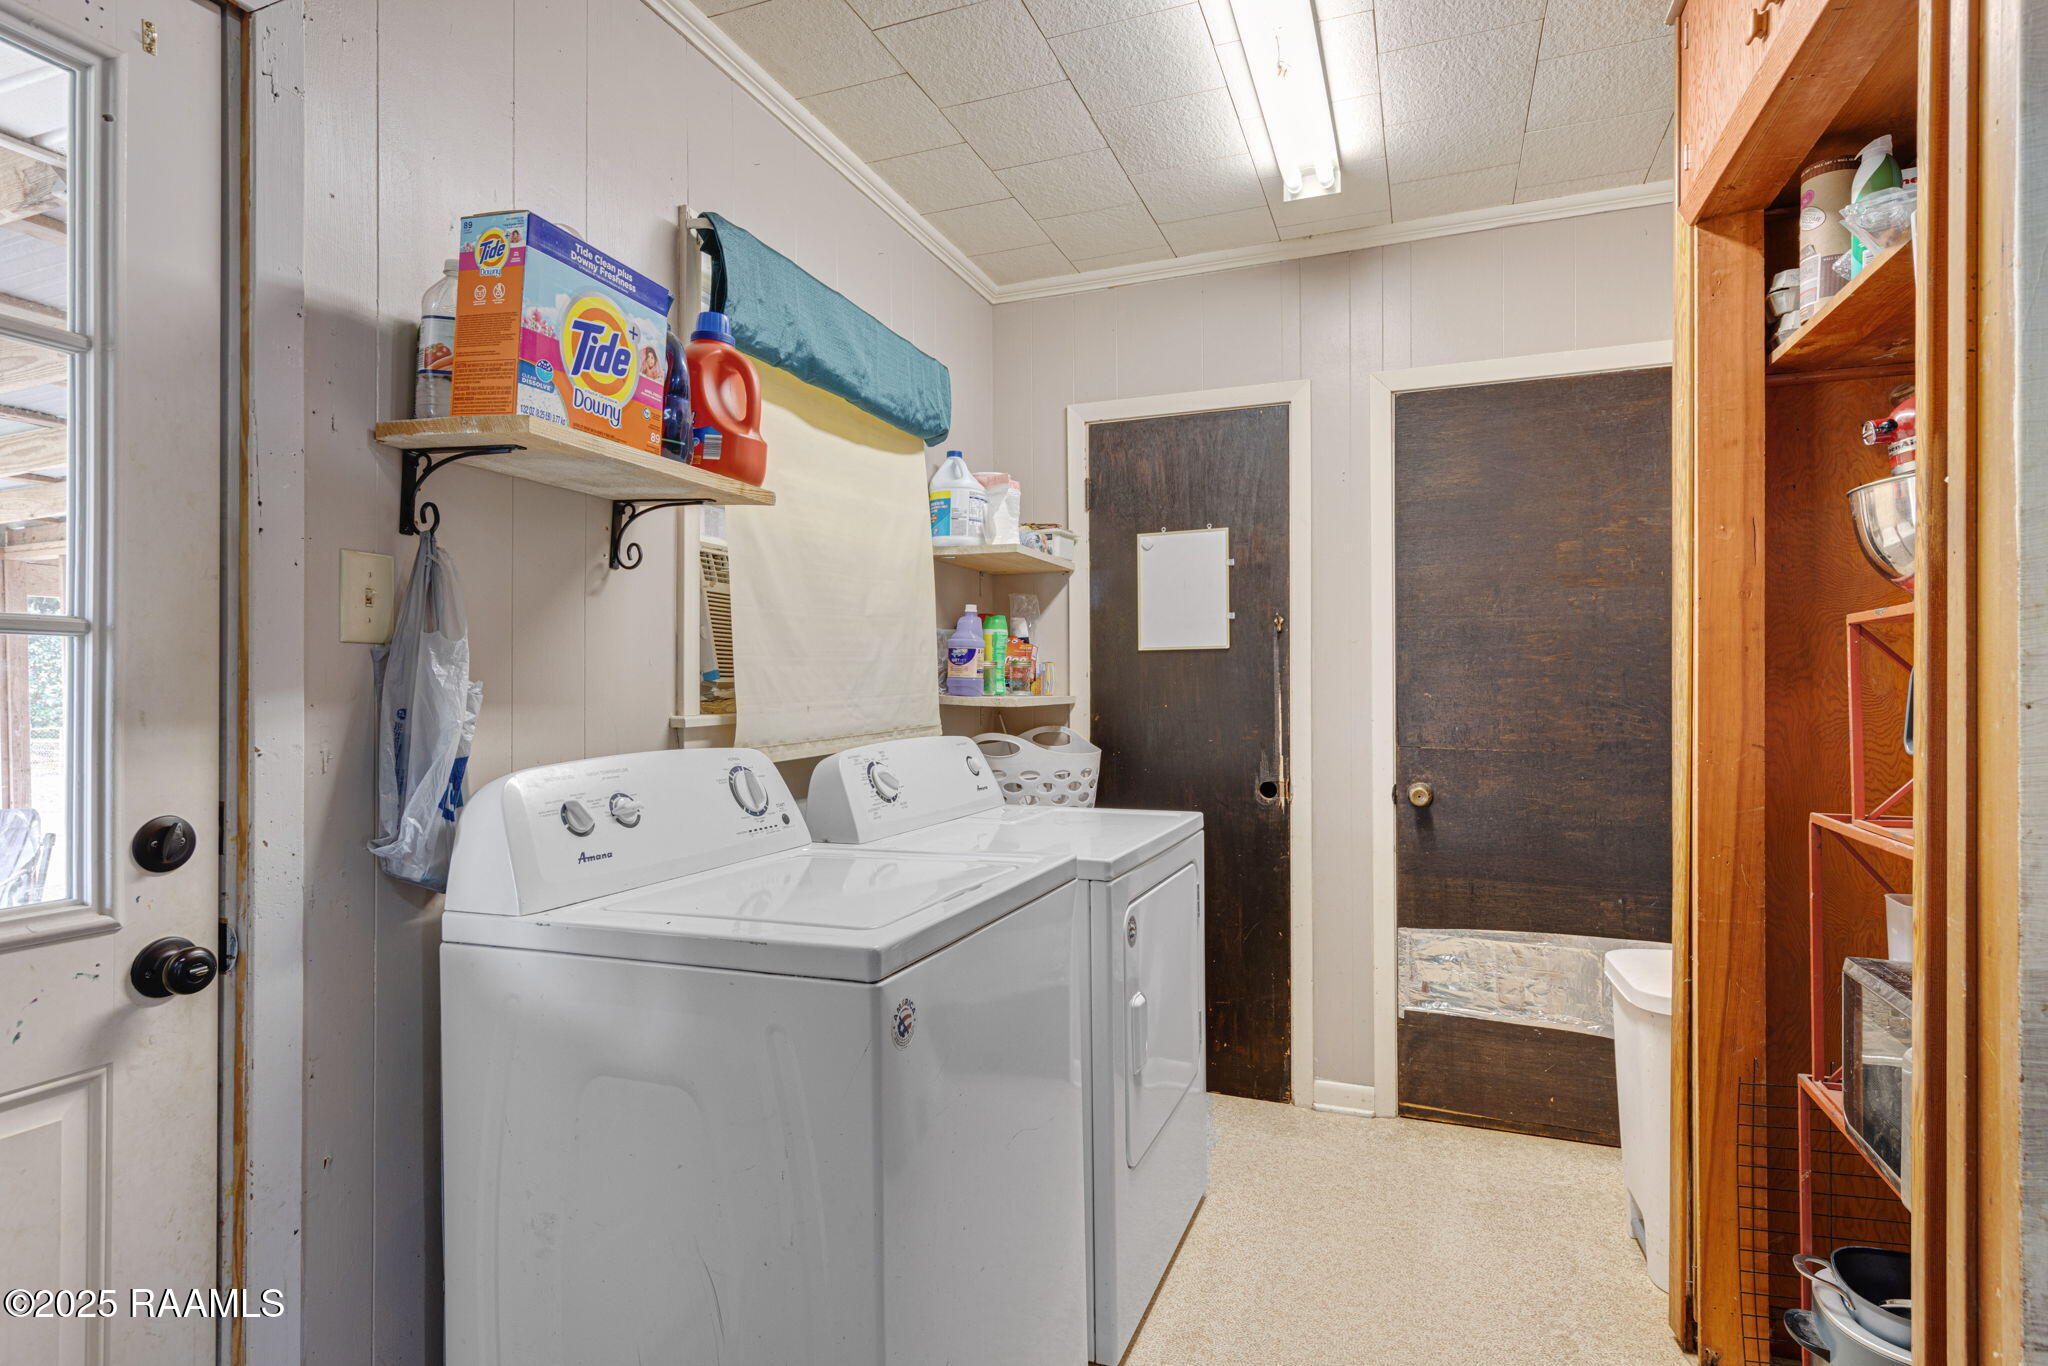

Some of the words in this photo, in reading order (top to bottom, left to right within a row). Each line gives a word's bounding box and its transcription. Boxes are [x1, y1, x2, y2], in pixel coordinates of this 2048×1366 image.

[479, 239, 506, 265] Tide
[575, 243, 593, 259] Tide
[594, 255, 616, 273] Clean
[617, 268, 633, 282] plus
[570, 250, 598, 273] Downy
[600, 267, 637, 292] Freshness
[571, 319, 632, 377] Tide
[522, 378, 551, 391] DISSOLVE
[574, 387, 621, 427] Downy
[650, 432, 660, 443] 89
[578, 852, 613, 864] Amana
